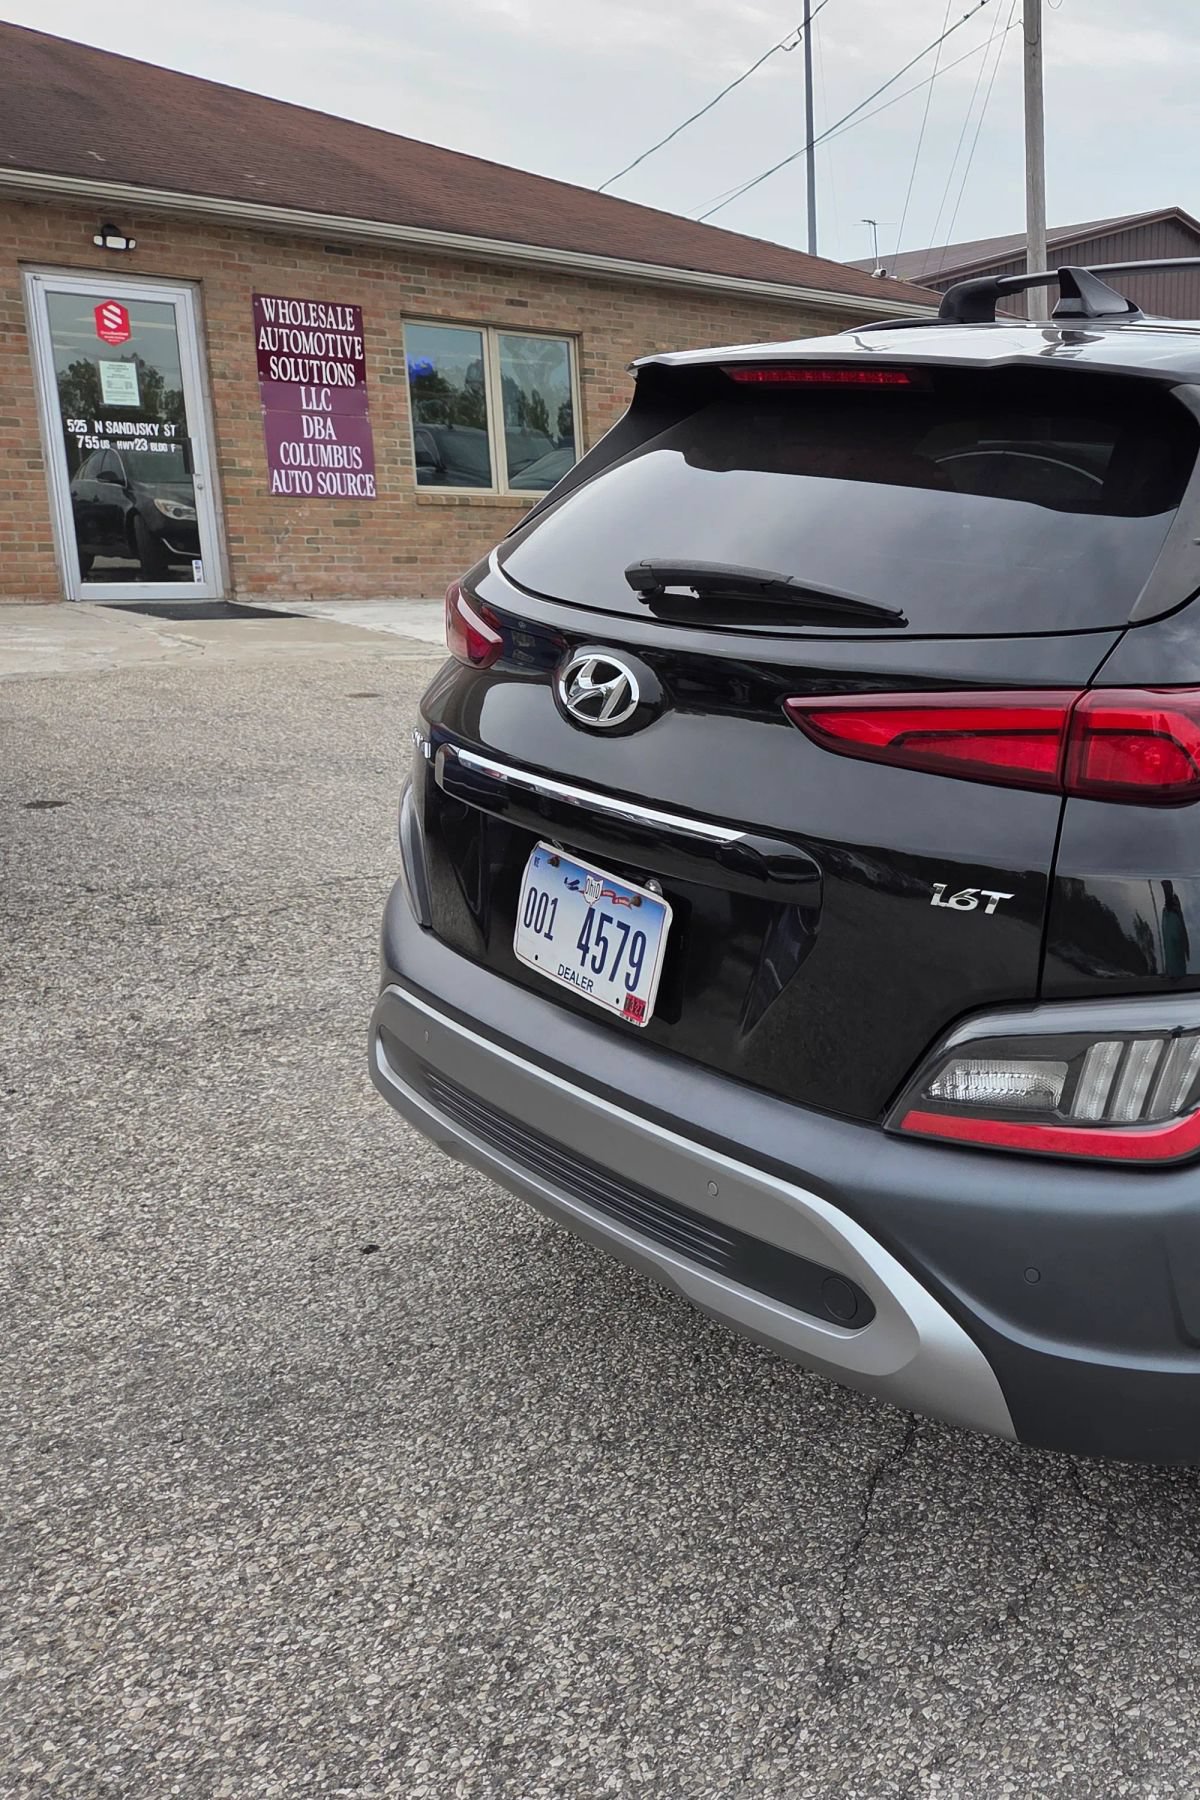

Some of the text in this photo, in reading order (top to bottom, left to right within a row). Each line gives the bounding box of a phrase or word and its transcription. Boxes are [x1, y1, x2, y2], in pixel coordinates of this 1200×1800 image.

[260, 297, 355, 331] WHOLESALE
[258, 326, 364, 360] AUTOMOTIVE
[269, 355, 356, 388] SOLUTIONS
[300, 386, 332, 411] LLC
[66, 418, 176, 437] 525 N SANDUSKY ST
[301, 414, 337, 440] DBA
[76, 434, 100, 449] 755
[170, 443, 176, 453] F
[279, 441, 363, 469] COLUMBUS
[271, 468, 376, 498] AUTO SOURCE
[523, 886, 647, 993] 001 4579
[557, 963, 595, 994] DEALER
